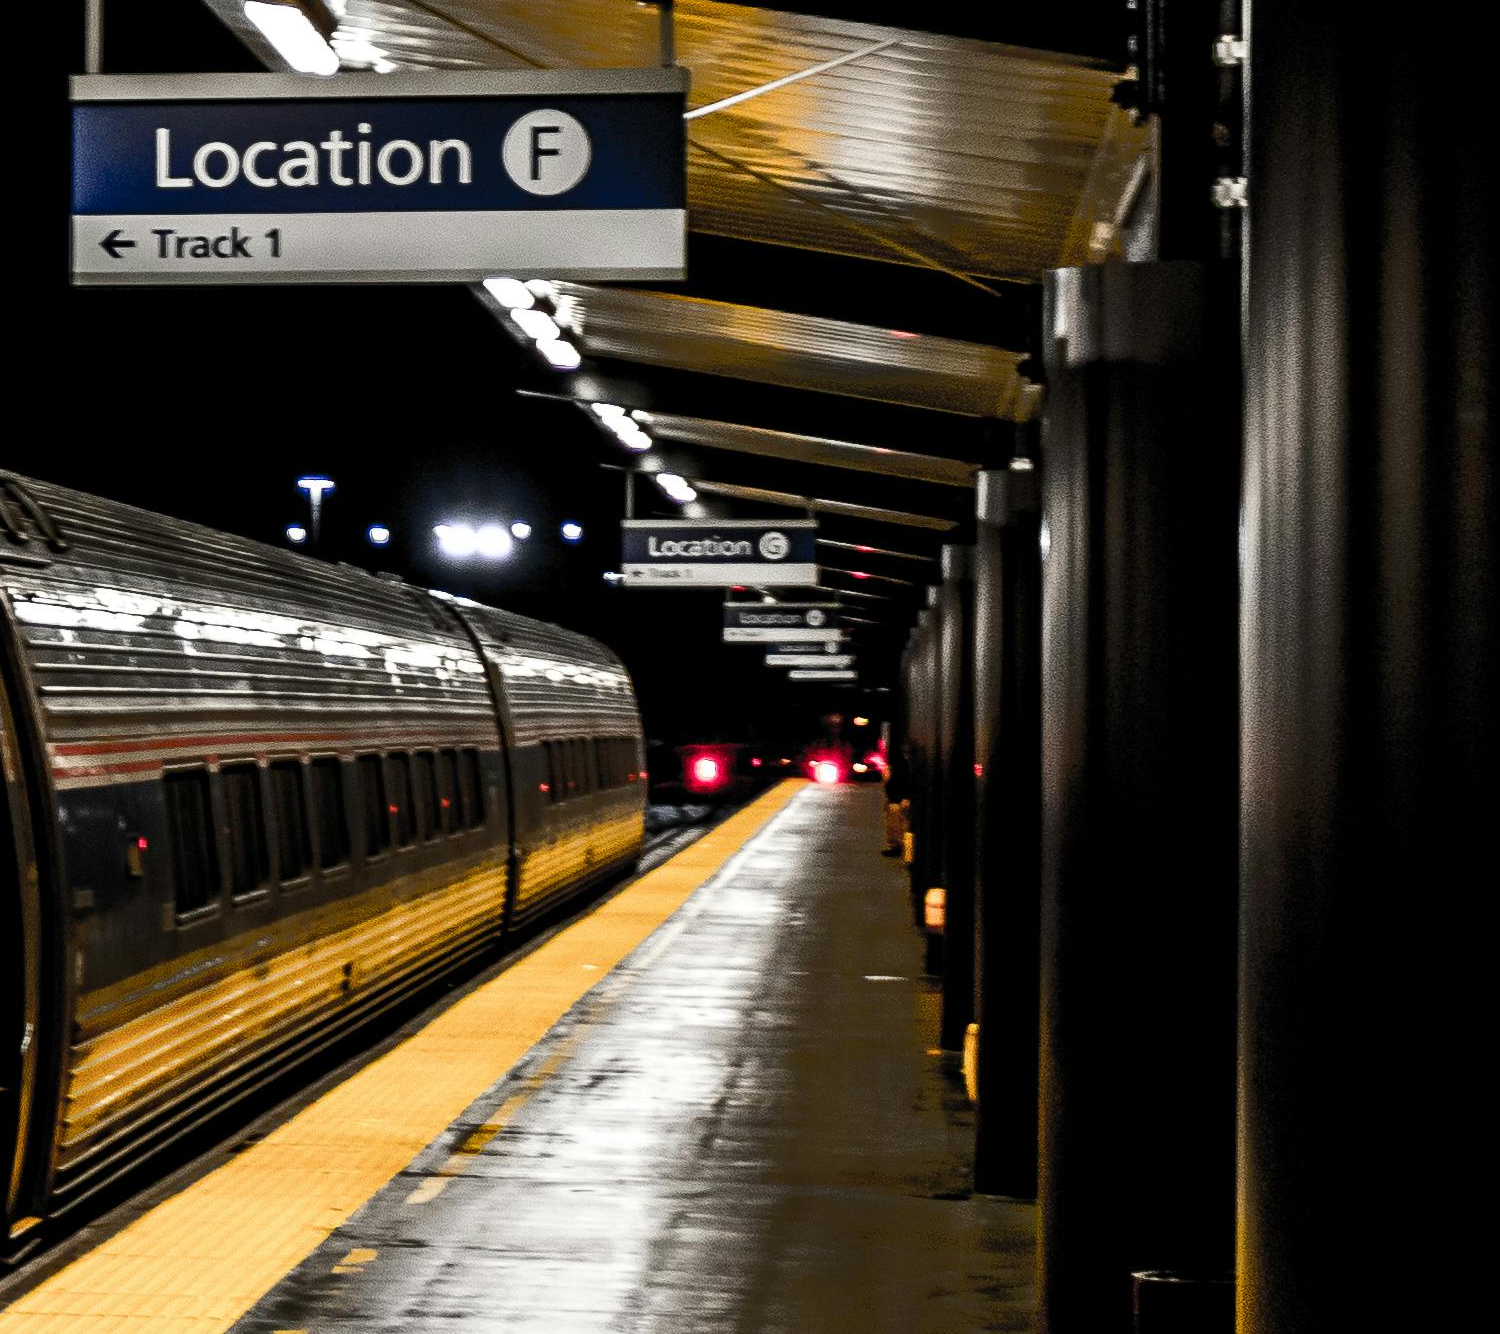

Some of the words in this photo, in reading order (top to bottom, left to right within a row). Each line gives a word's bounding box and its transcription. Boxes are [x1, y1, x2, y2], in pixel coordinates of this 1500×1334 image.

[154, 124, 472, 188] Location
[528, 126, 561, 181] F
[152, 225, 252, 259] Track
[266, 228, 282, 258] 1
[648, 535, 752, 557] Location
